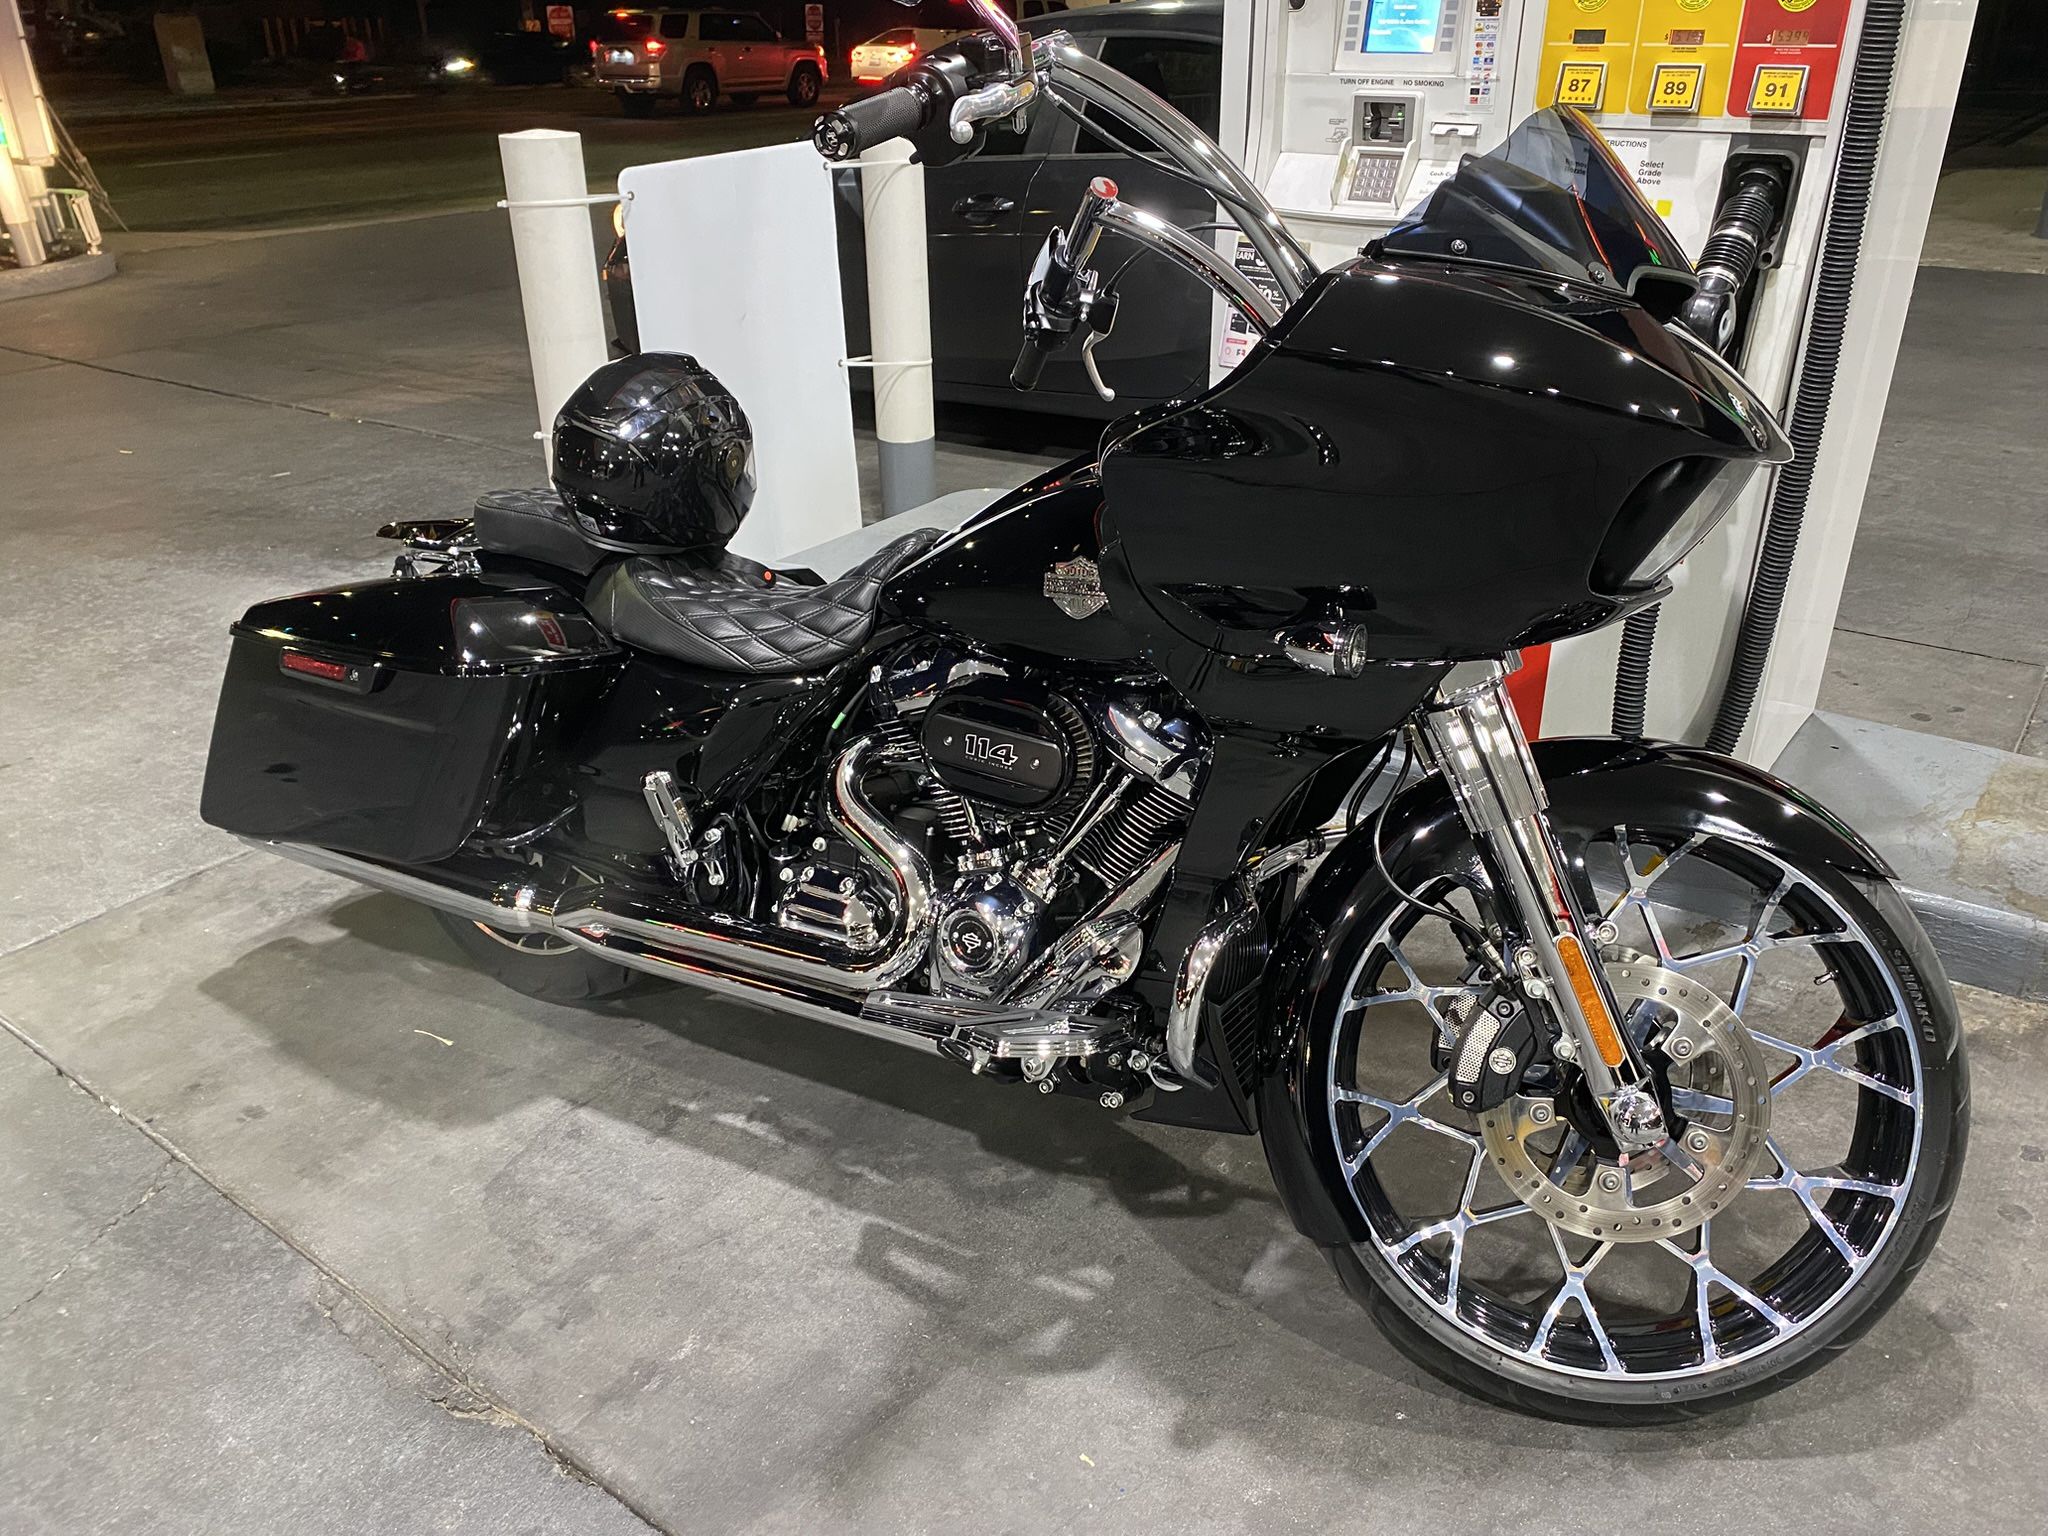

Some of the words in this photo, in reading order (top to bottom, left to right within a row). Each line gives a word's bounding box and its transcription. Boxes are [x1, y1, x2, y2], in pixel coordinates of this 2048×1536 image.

[1568, 79, 1591, 93] 87
[1663, 81, 1687, 95] 89
[1765, 83, 1788, 97] 91
[1640, 160, 1665, 168] Select
[1638, 169, 1662, 177] Grade
[1636, 177, 1661, 185] Above
[1236, 251, 1255, 260] EARN
[965, 733, 1018, 766] 114
[965, 755, 985, 764] CUBIC
[988, 761, 1013, 771] INCHES
[1887, 948, 1937, 1042] SHINKO
